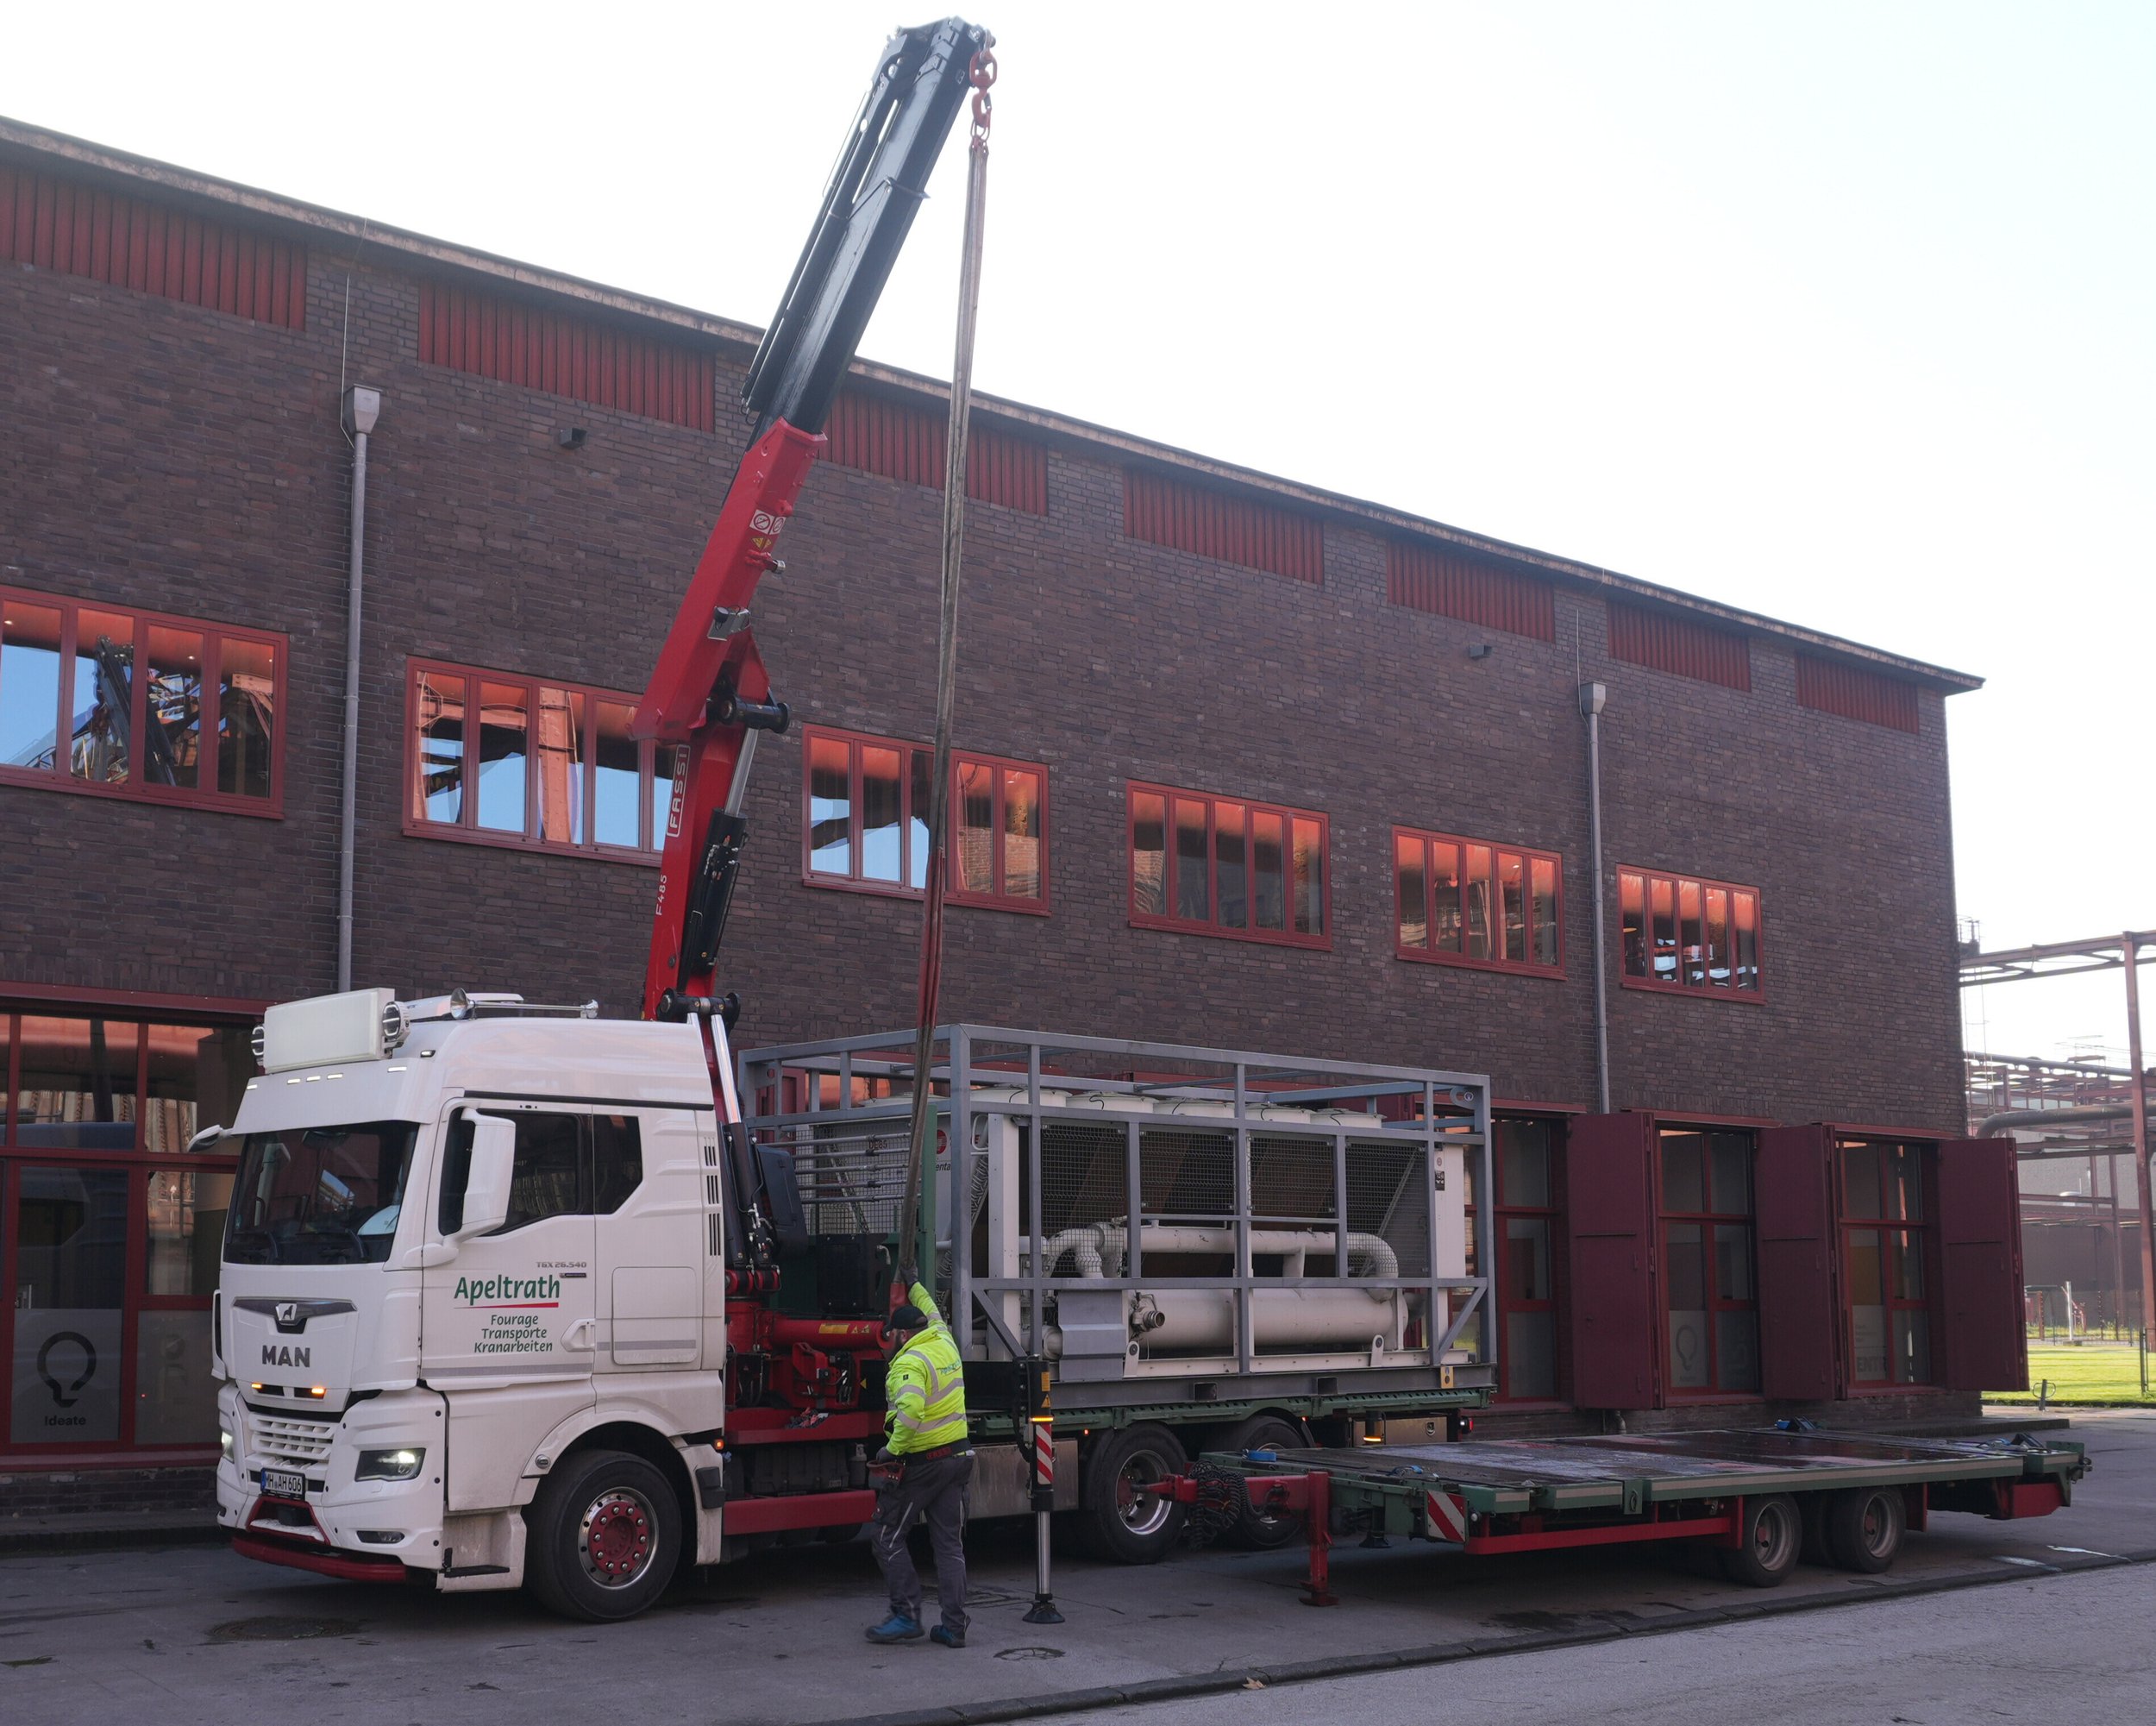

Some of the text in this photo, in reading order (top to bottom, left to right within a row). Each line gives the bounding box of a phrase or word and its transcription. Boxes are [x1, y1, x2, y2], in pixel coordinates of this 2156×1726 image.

[669, 751, 686, 829] FASSI
[936, 1162, 951, 1171] enta
[454, 1274, 560, 1306] Apeltrath
[491, 1315, 539, 1327] Fourage
[481, 1327, 547, 1341] Transporte
[474, 1340, 553, 1353] Kranarbeiten
[261, 1345, 310, 1368] MAN
[45, 1415, 86, 1426] Ideate
